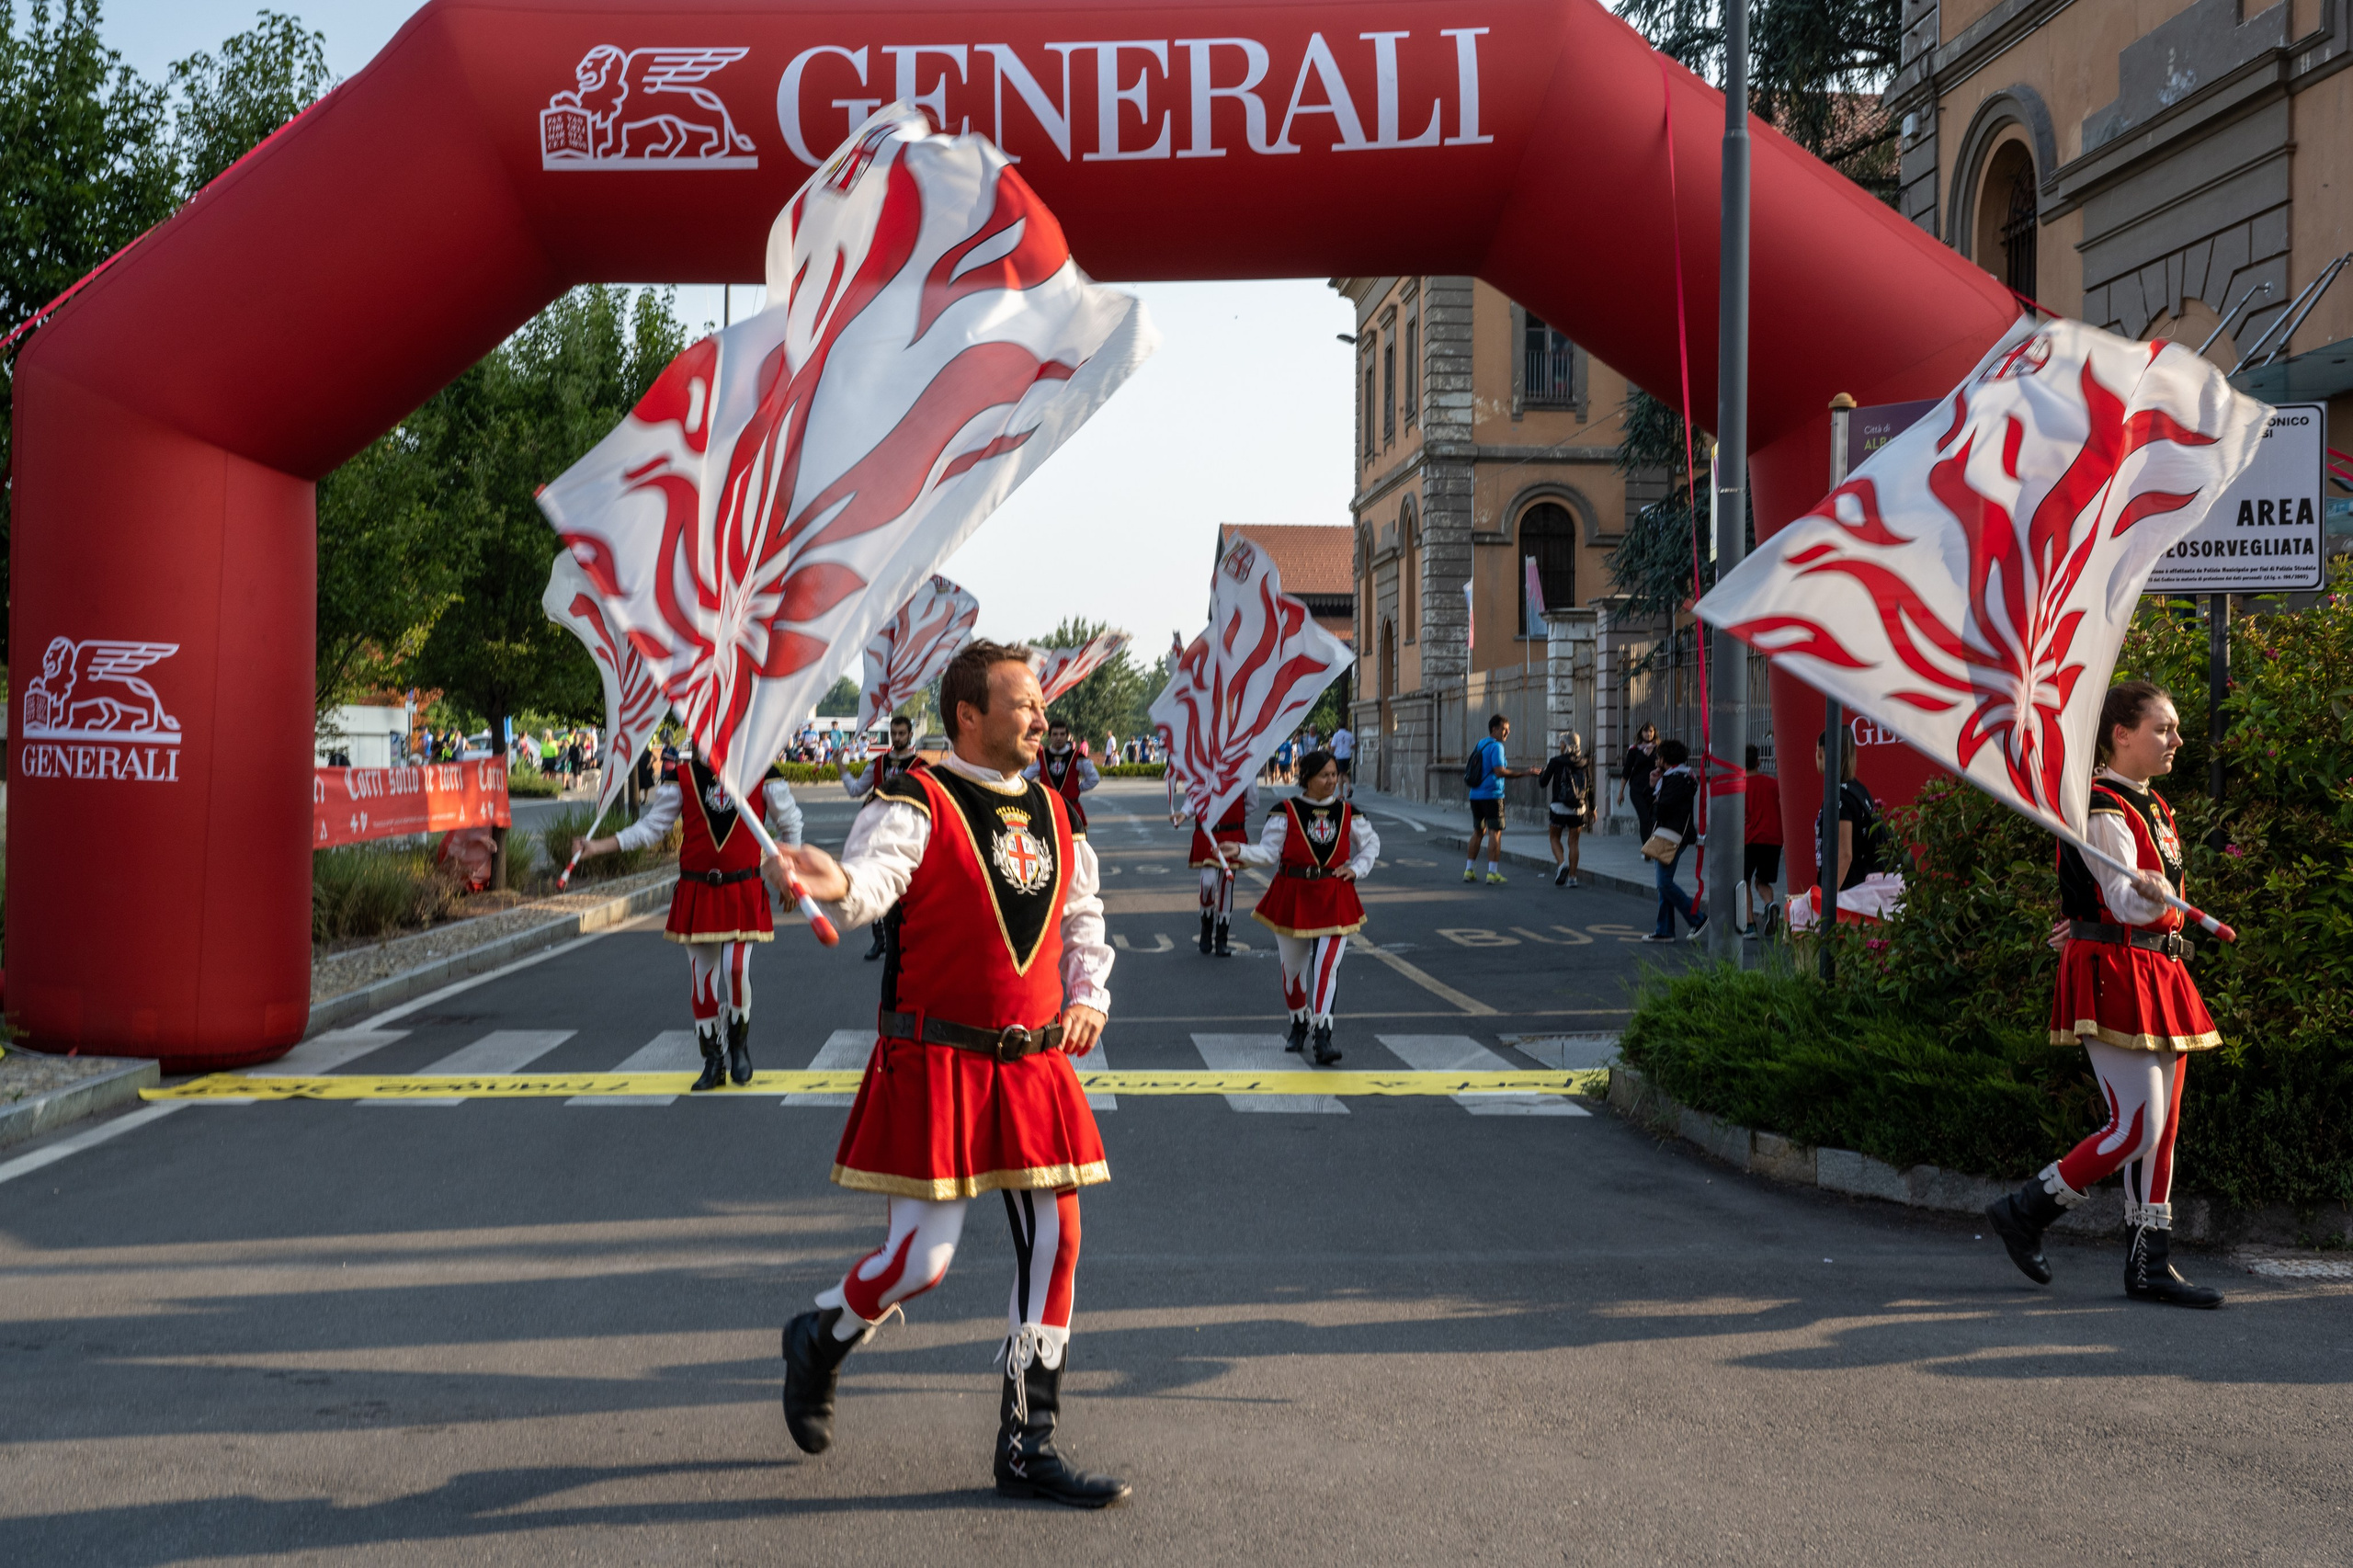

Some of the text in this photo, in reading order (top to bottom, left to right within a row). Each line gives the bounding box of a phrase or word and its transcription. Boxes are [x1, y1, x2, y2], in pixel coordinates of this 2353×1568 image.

[775, 27, 1495, 166] GENERALI
[1863, 423, 1891, 435] Città di
[2267, 416, 2310, 427] ONICO
[1863, 436, 1893, 450] ALB
[2236, 497, 2314, 527] AREA
[2163, 538, 2314, 559] EOSORVEGLIATA
[22, 744, 181, 782] GENERALI
[1435, 924, 1652, 948] BUS
